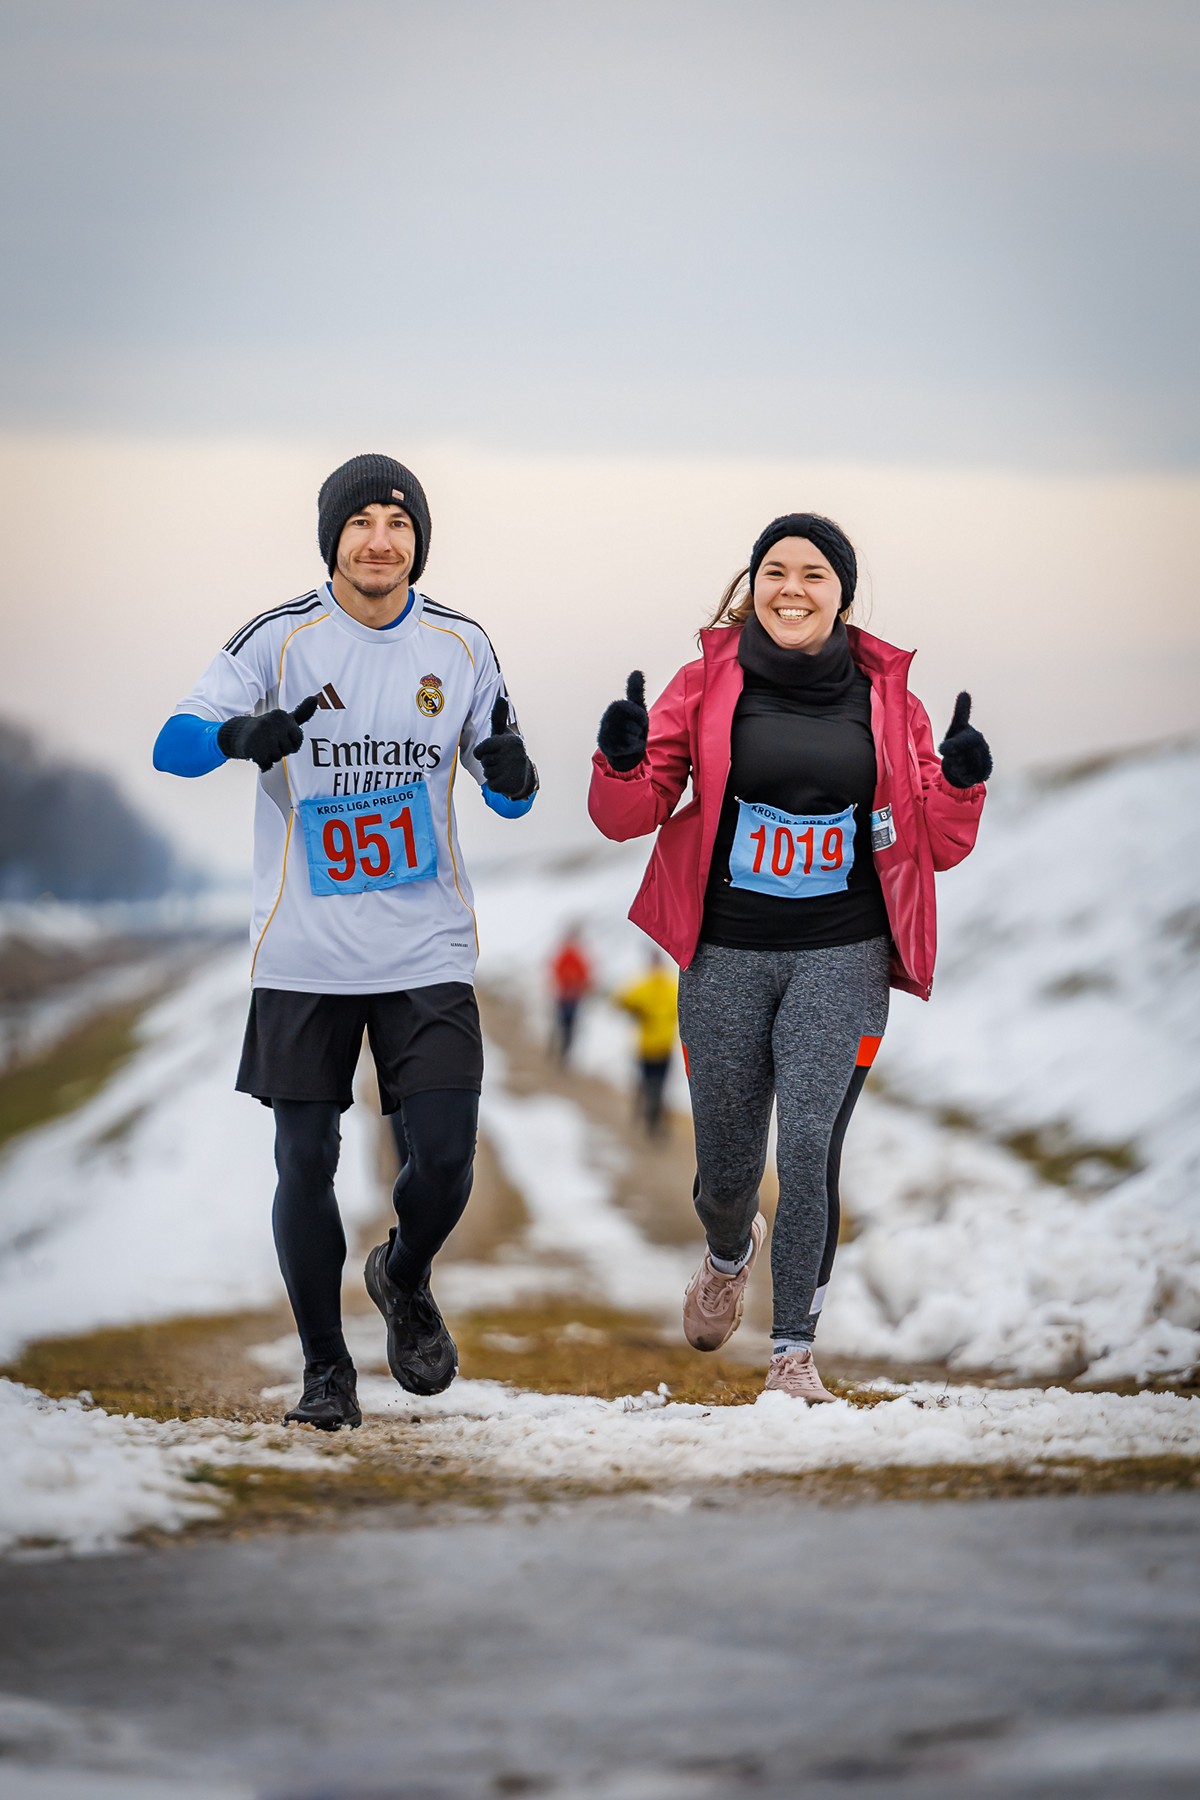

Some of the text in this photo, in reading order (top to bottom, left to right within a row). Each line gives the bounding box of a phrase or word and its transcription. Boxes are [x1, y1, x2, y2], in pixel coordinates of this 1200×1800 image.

[310, 734, 442, 768] Emirates
[333, 772, 360, 796] FLY
[317, 790, 414, 815] KROS LIGA PRELOG
[751, 804, 777, 820] KROS
[322, 806, 418, 881] 951
[750, 825, 844, 876] 1019
